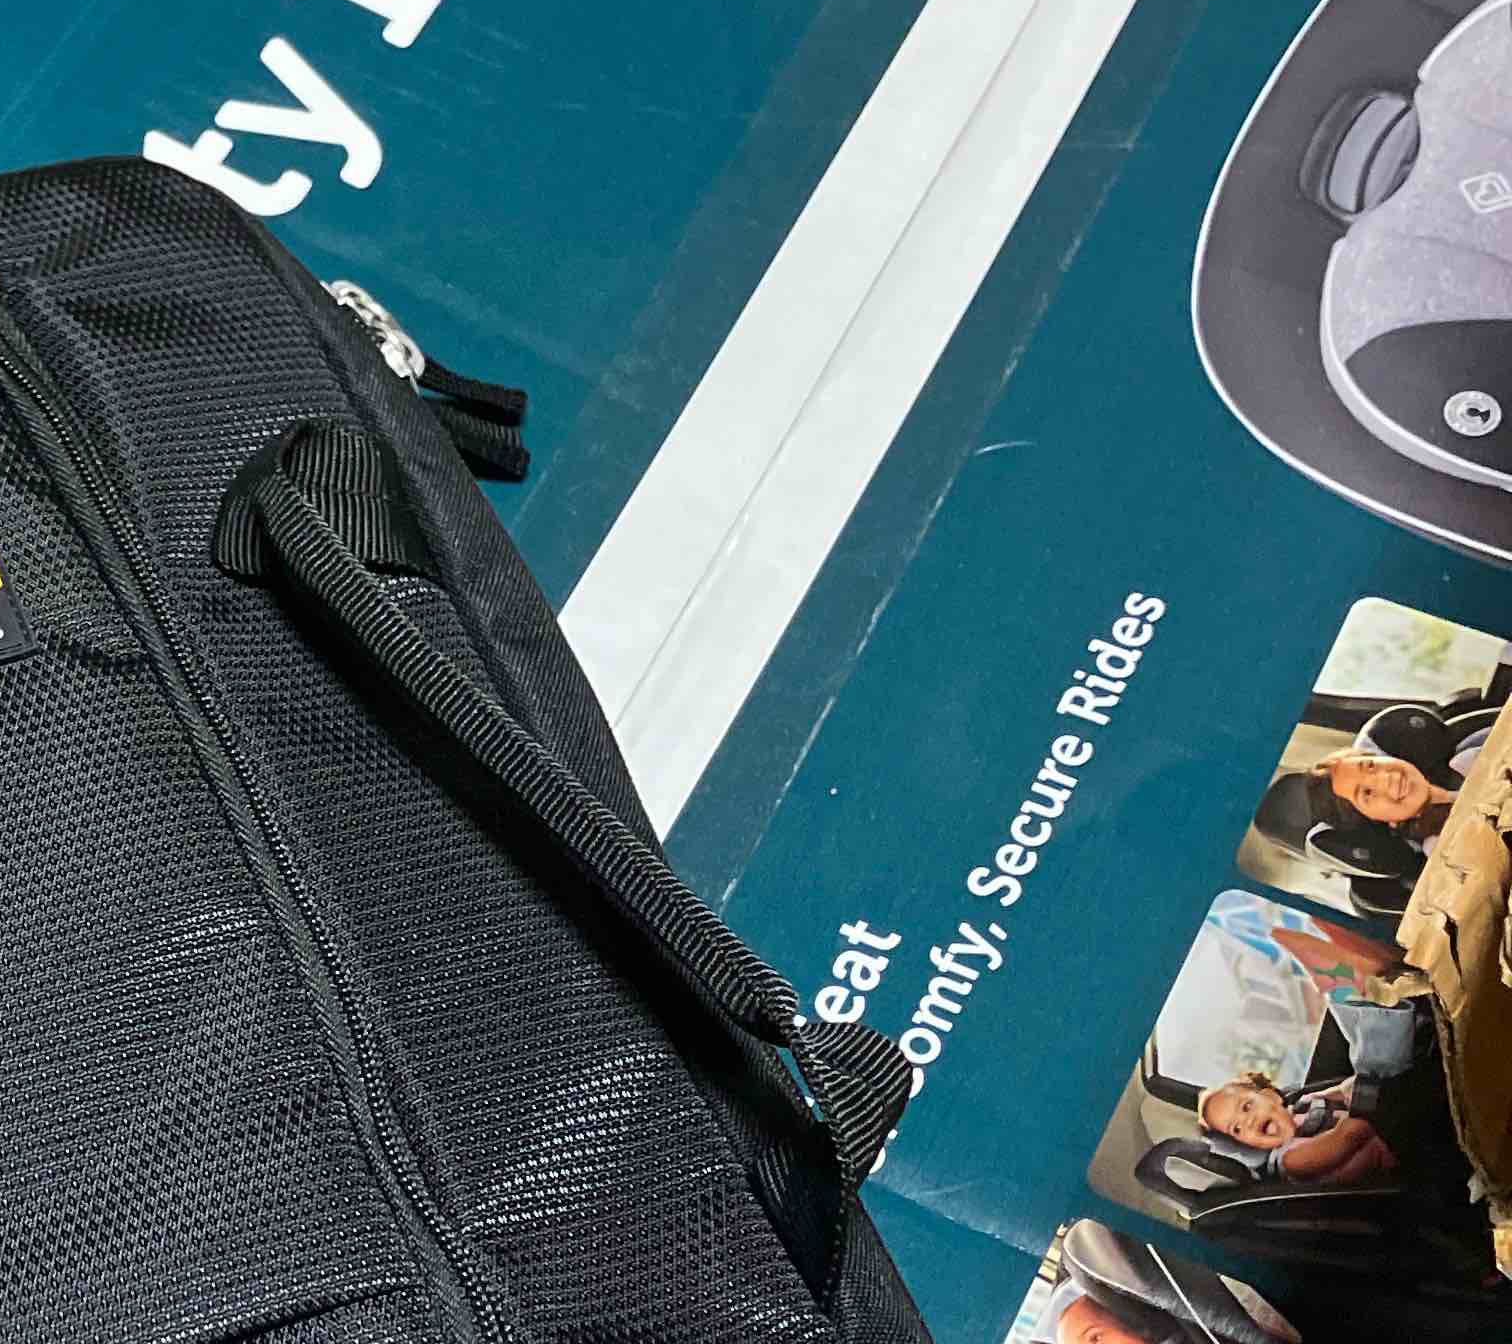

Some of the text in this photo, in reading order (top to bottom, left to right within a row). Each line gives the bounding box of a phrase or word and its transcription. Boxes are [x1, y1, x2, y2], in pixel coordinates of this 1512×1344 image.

[967, 734, 1094, 907] Secure
[1056, 592, 1166, 725] Rides
[792, 919, 902, 1027] eat
